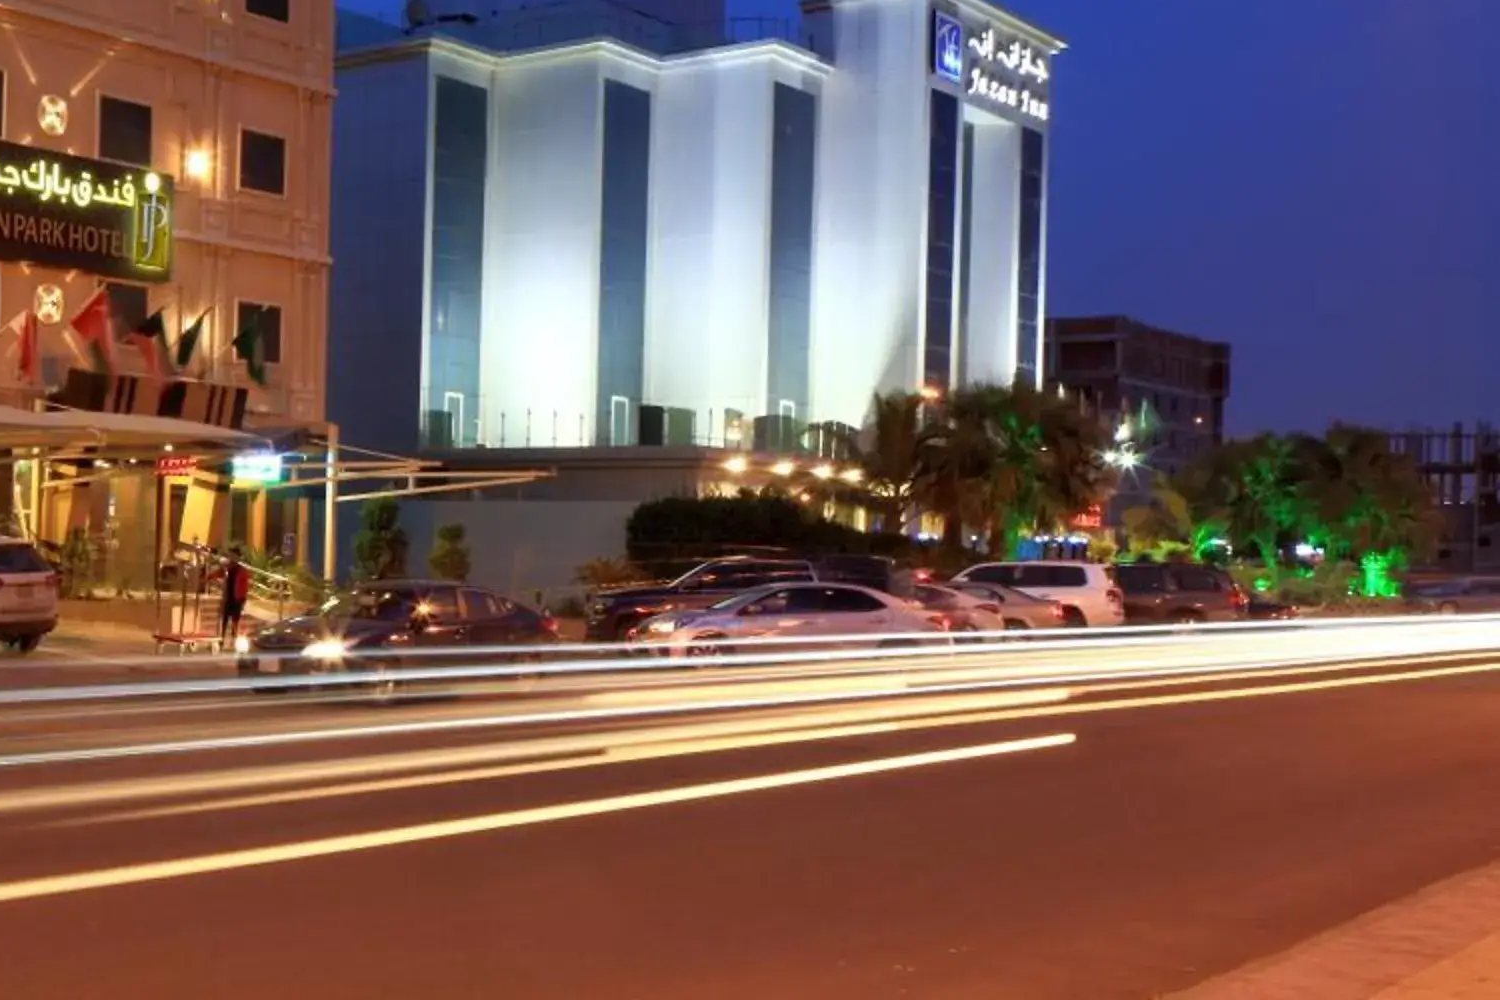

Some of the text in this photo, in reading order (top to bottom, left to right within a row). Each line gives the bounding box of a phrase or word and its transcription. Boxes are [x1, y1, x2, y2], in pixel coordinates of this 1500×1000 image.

[968, 68, 1049, 120] Jazan Inn
[22, 160, 71, 204] بارك
[72, 171, 136, 207] فندق
[14, 213, 65, 248] PARK
[69, 224, 133, 258] HOTEL
